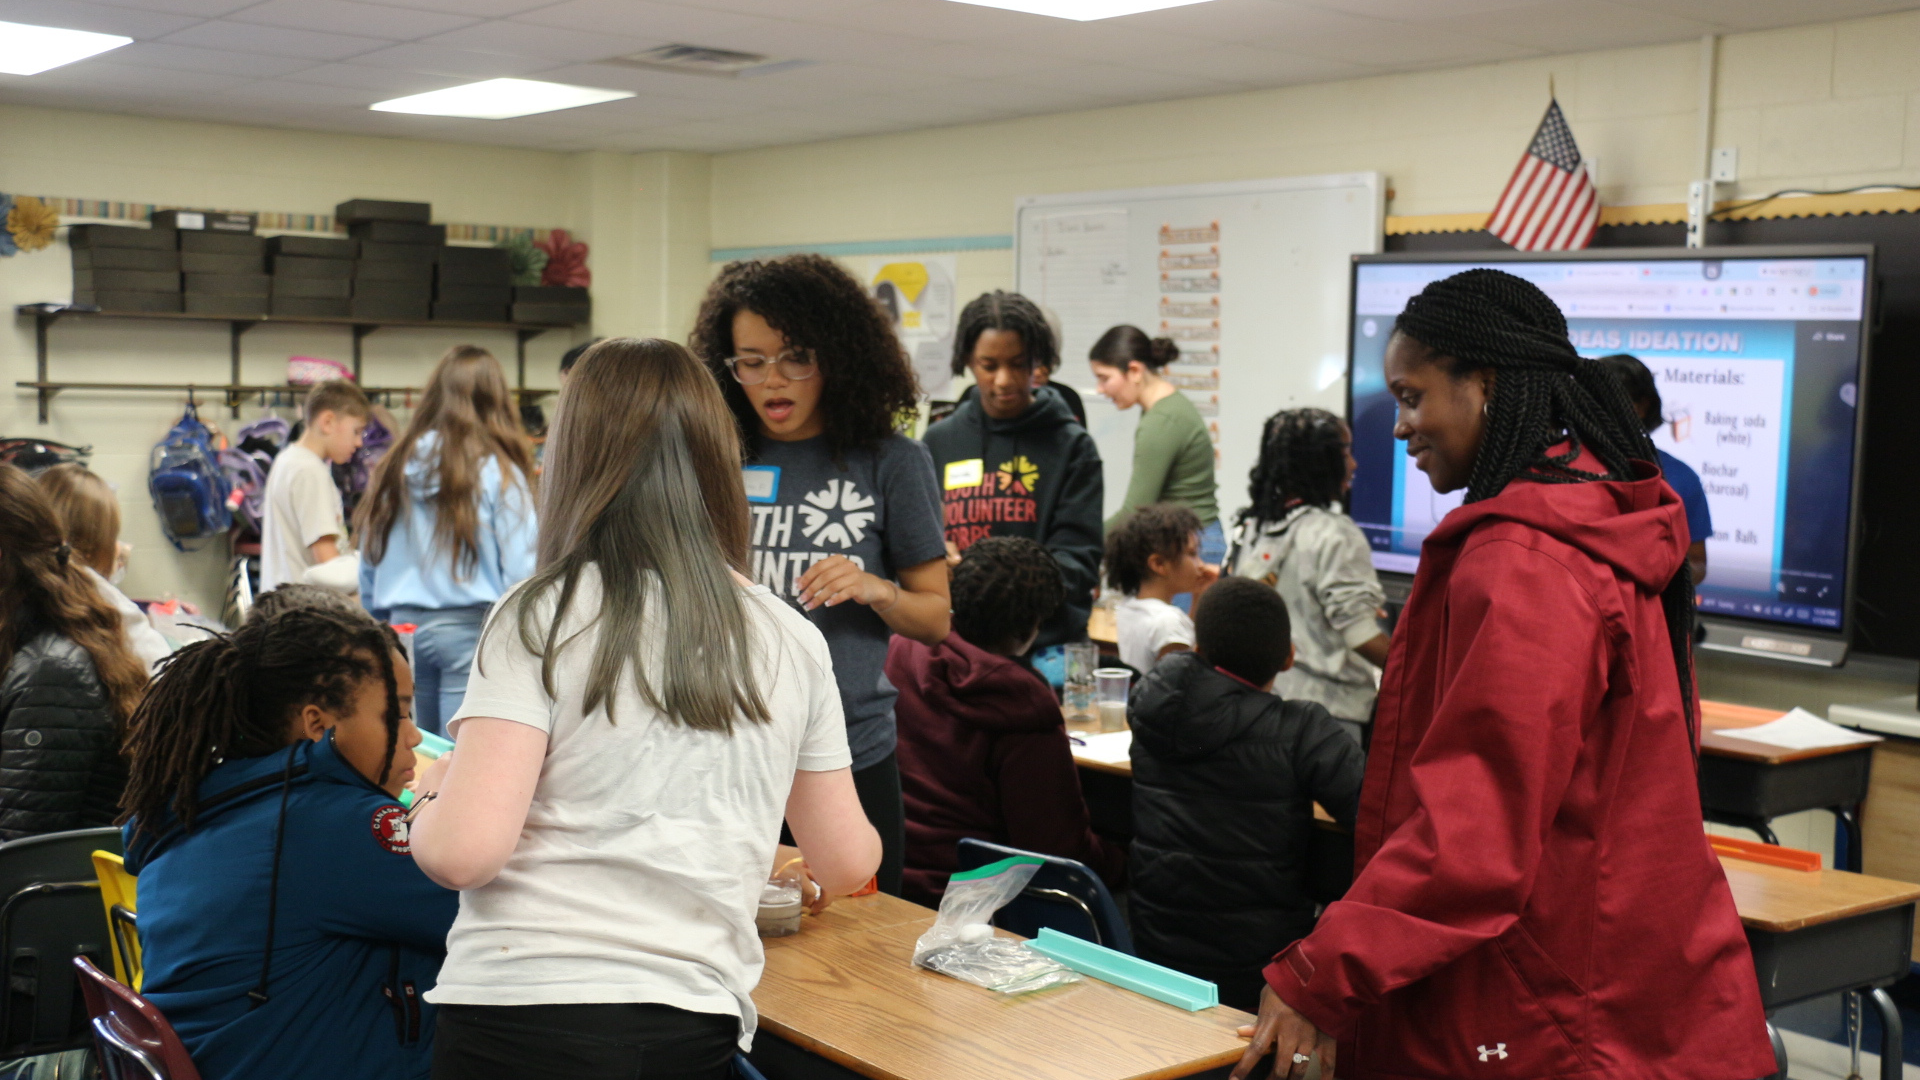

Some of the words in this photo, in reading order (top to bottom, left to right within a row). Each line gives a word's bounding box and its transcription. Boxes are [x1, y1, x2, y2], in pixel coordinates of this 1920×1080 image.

[1567, 330, 1621, 349] DEAS
[1629, 330, 1741, 352] IDEATION
[1664, 369, 1745, 385] Materials:
[1704, 411, 1737, 430] Baking
[1743, 414, 1766, 428] soda
[1716, 431, 1751, 448] (white)
[1701, 461, 1738, 478] Biochar
[1735, 529, 1757, 545] Balls
